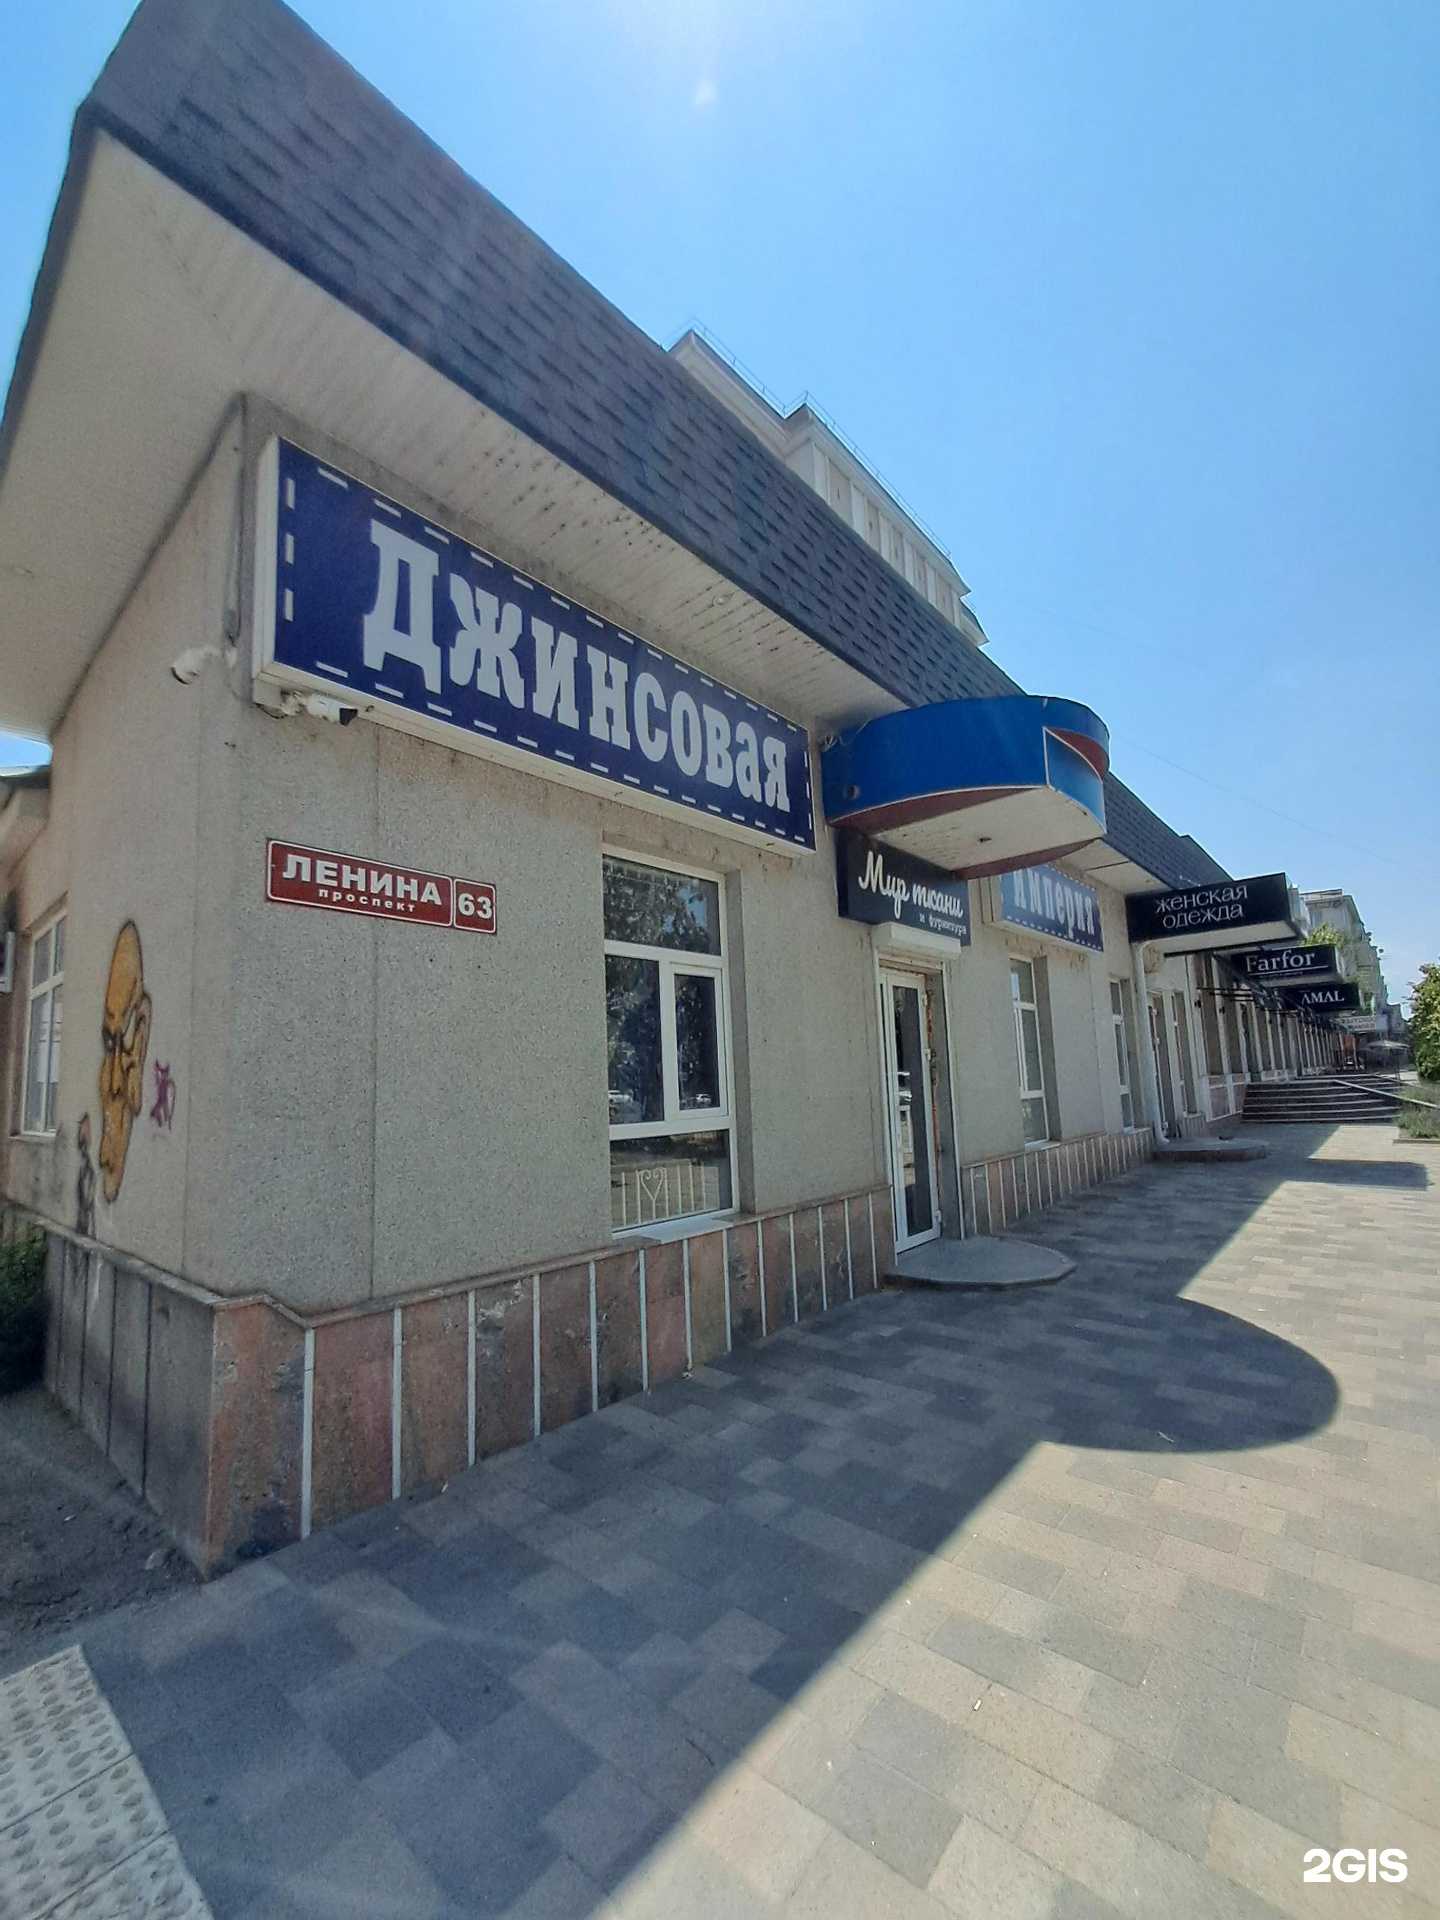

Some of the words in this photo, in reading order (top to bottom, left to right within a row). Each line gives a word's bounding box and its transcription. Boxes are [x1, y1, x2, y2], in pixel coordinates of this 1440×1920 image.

[363, 518, 791, 812] Джинсовая
[283, 854, 442, 905] ЛЕНИНА
[458, 893, 493, 919] 63
[858, 850, 910, 919] Мир
[911, 882, 963, 918] ткани
[319, 888, 415, 912] проспект
[1162, 903, 1244, 929] одежда
[1246, 949, 1315, 972] Farfor
[1301, 990, 1344, 1005] AMAL
